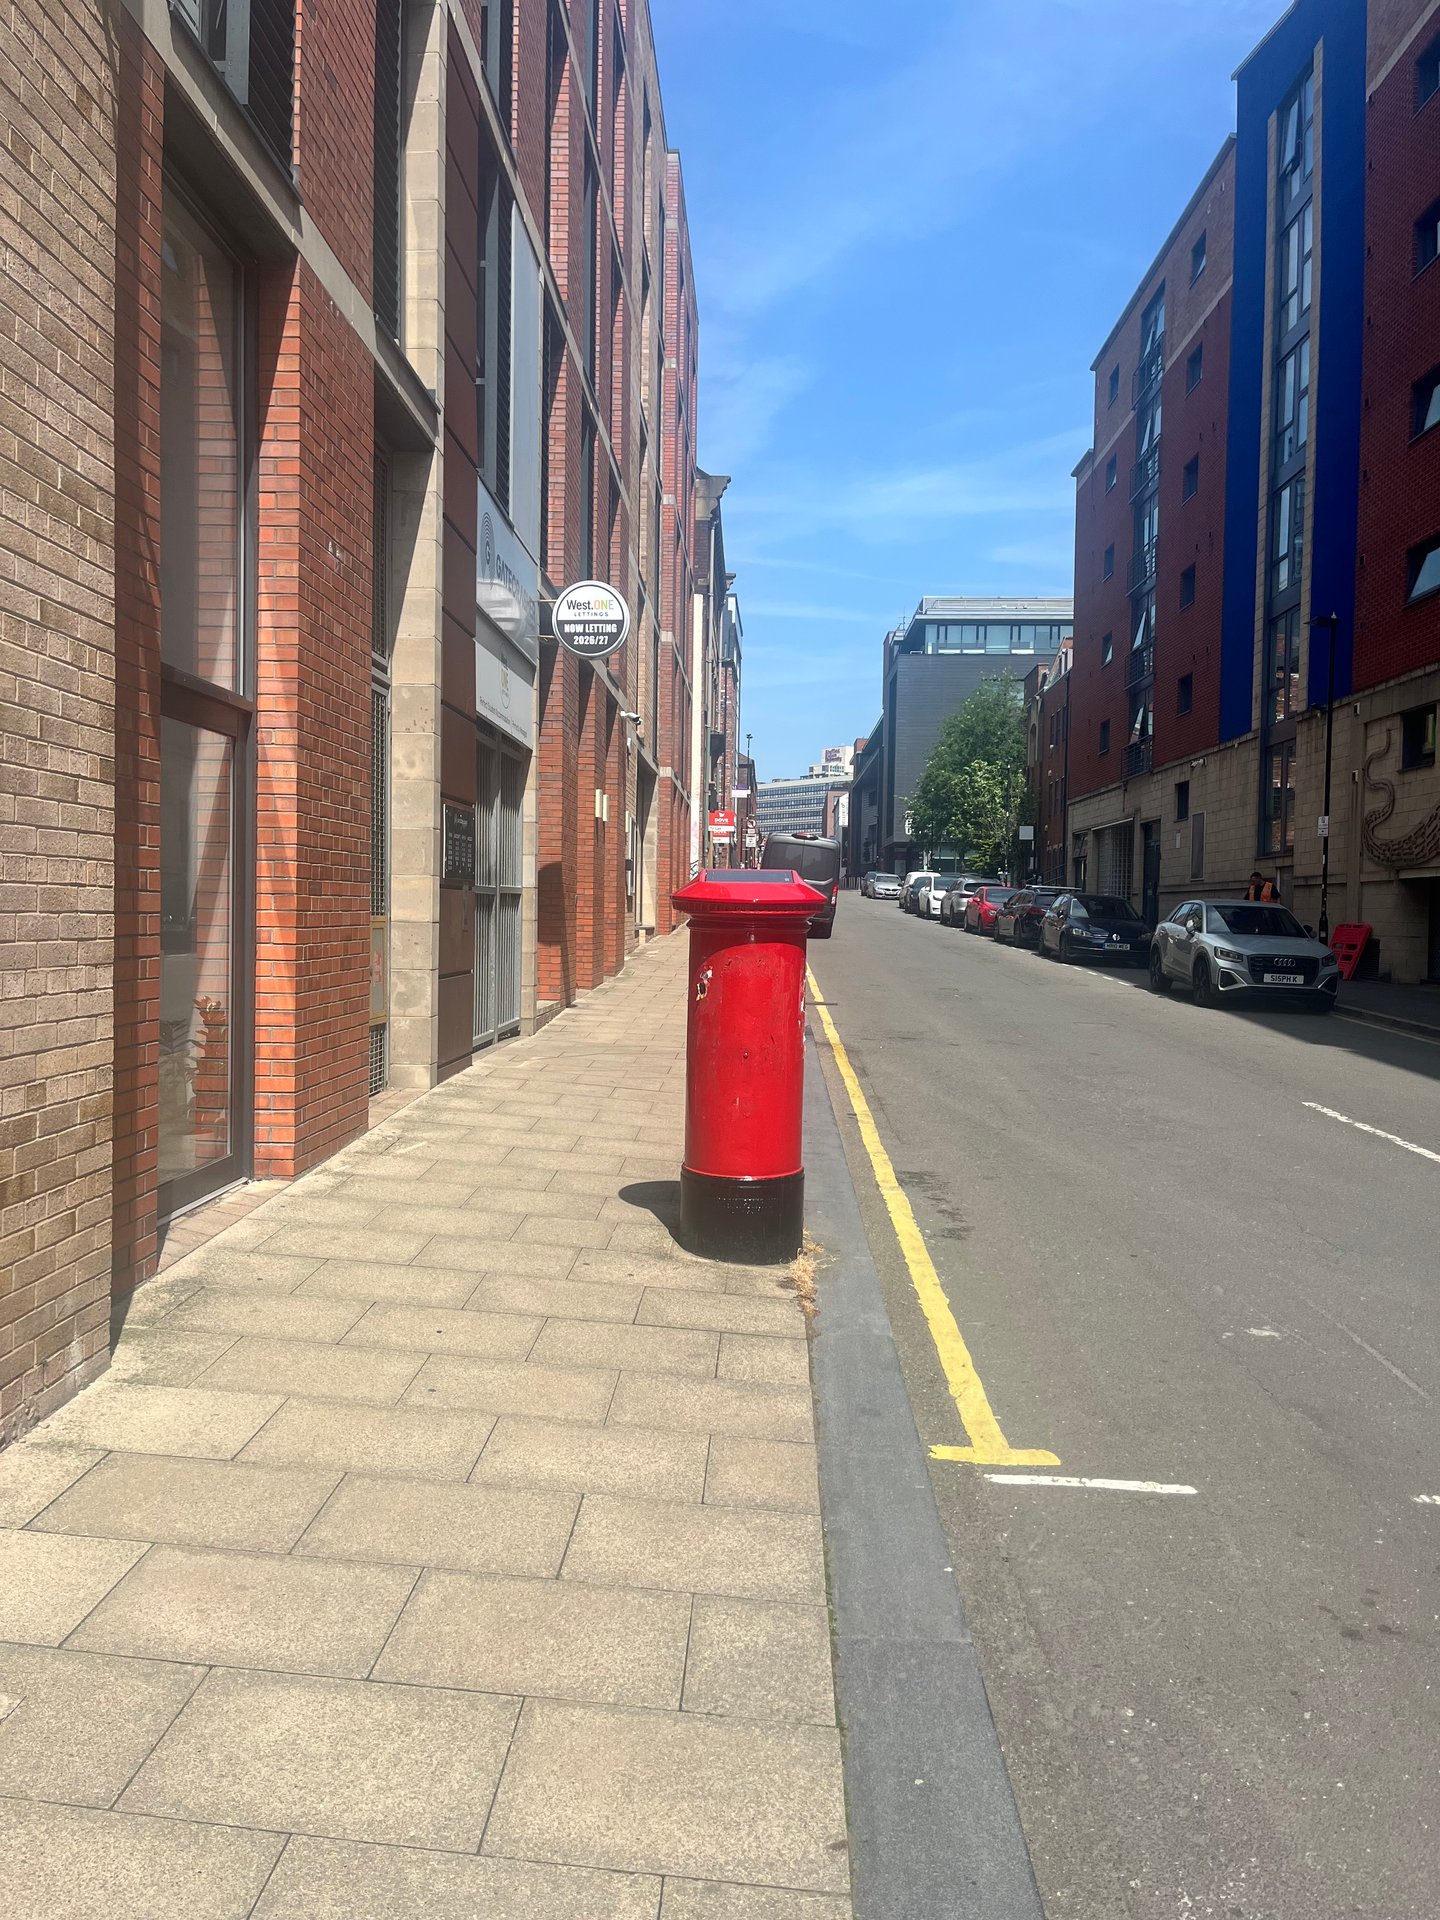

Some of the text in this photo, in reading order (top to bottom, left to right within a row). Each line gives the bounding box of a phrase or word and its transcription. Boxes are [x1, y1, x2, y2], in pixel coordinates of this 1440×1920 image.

[566, 599, 614, 610] West.ONE
[564, 623, 618, 633] NOW LETTING
[573, 635, 609, 645] 2026/27
